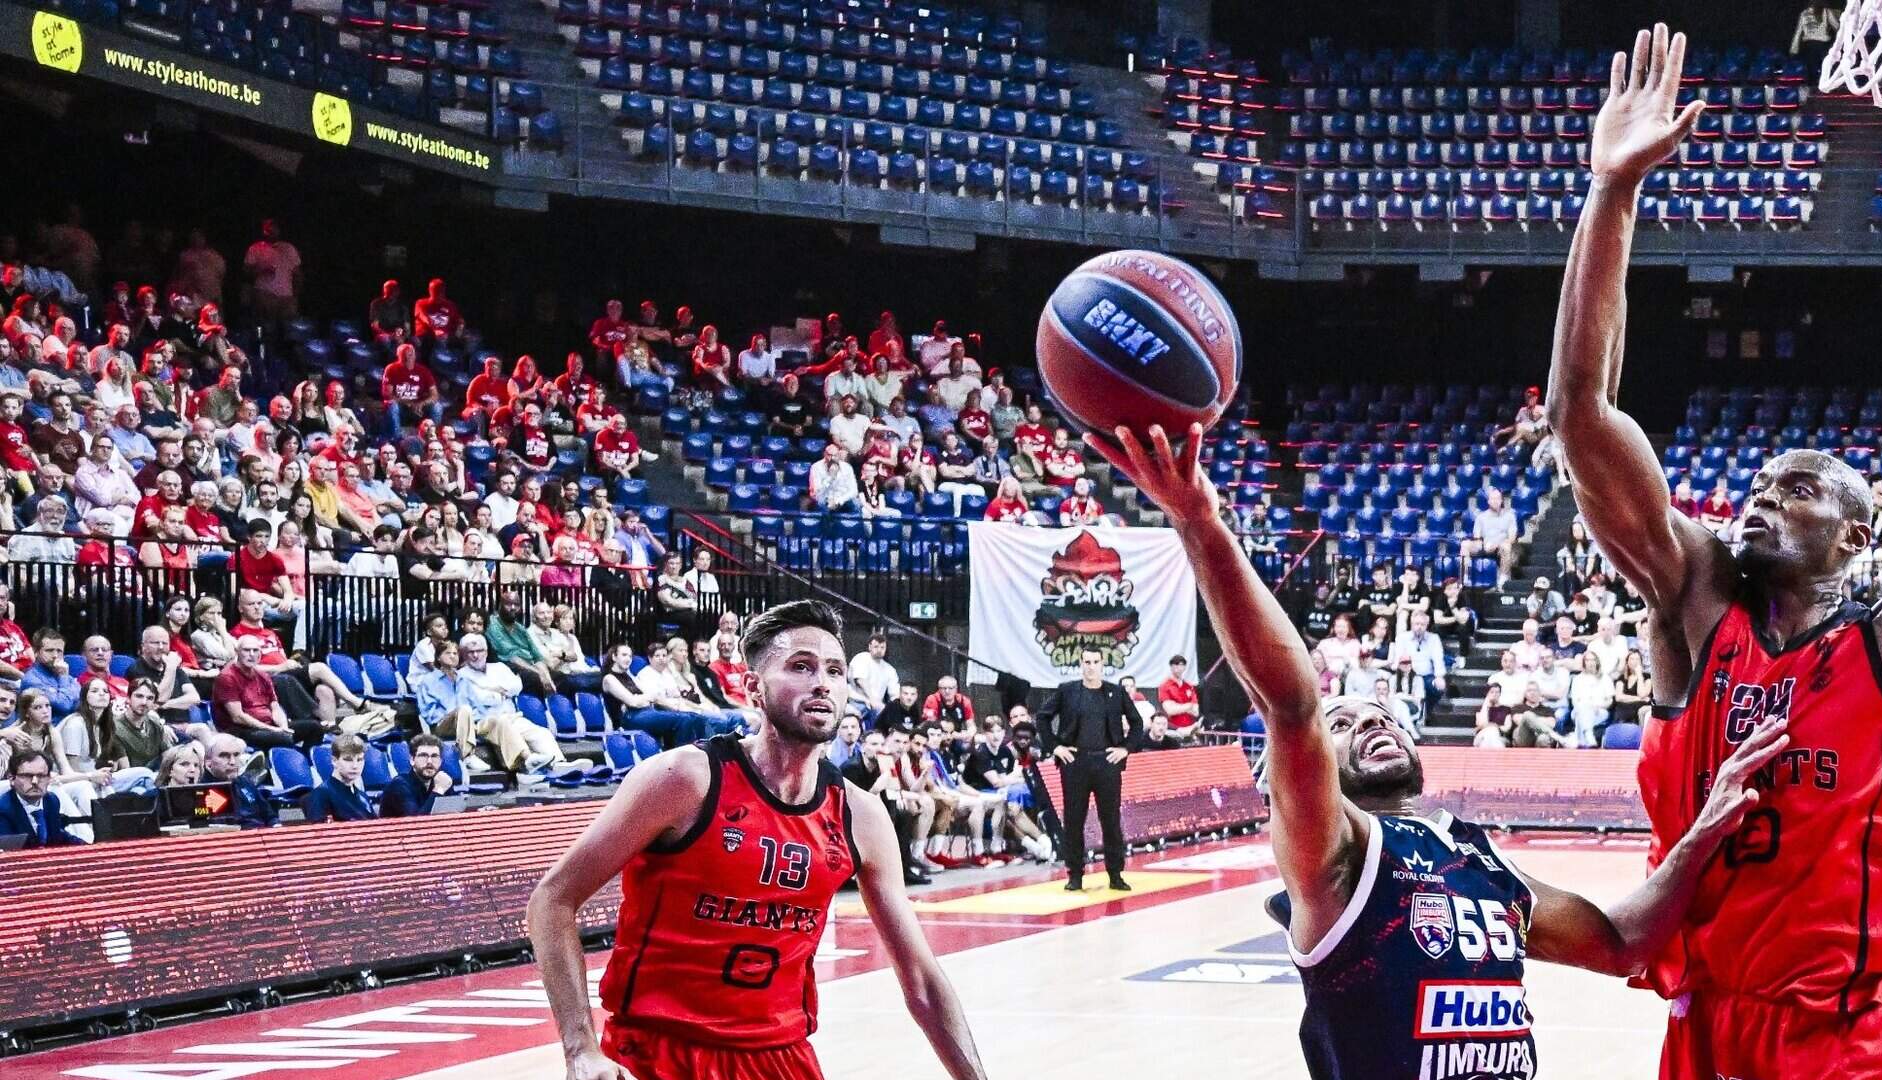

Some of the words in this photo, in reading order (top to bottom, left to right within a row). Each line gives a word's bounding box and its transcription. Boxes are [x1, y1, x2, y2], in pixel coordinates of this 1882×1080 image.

[104, 48, 262, 106] www.styleathome.be
[366, 122, 490, 170] www.styleathome.be
[1051, 646, 1126, 669] GIATS
[1725, 677, 1796, 745] 24
[760, 836, 811, 890] 13
[693, 893, 820, 934] GIANTS
[1452, 896, 1517, 961] 55
